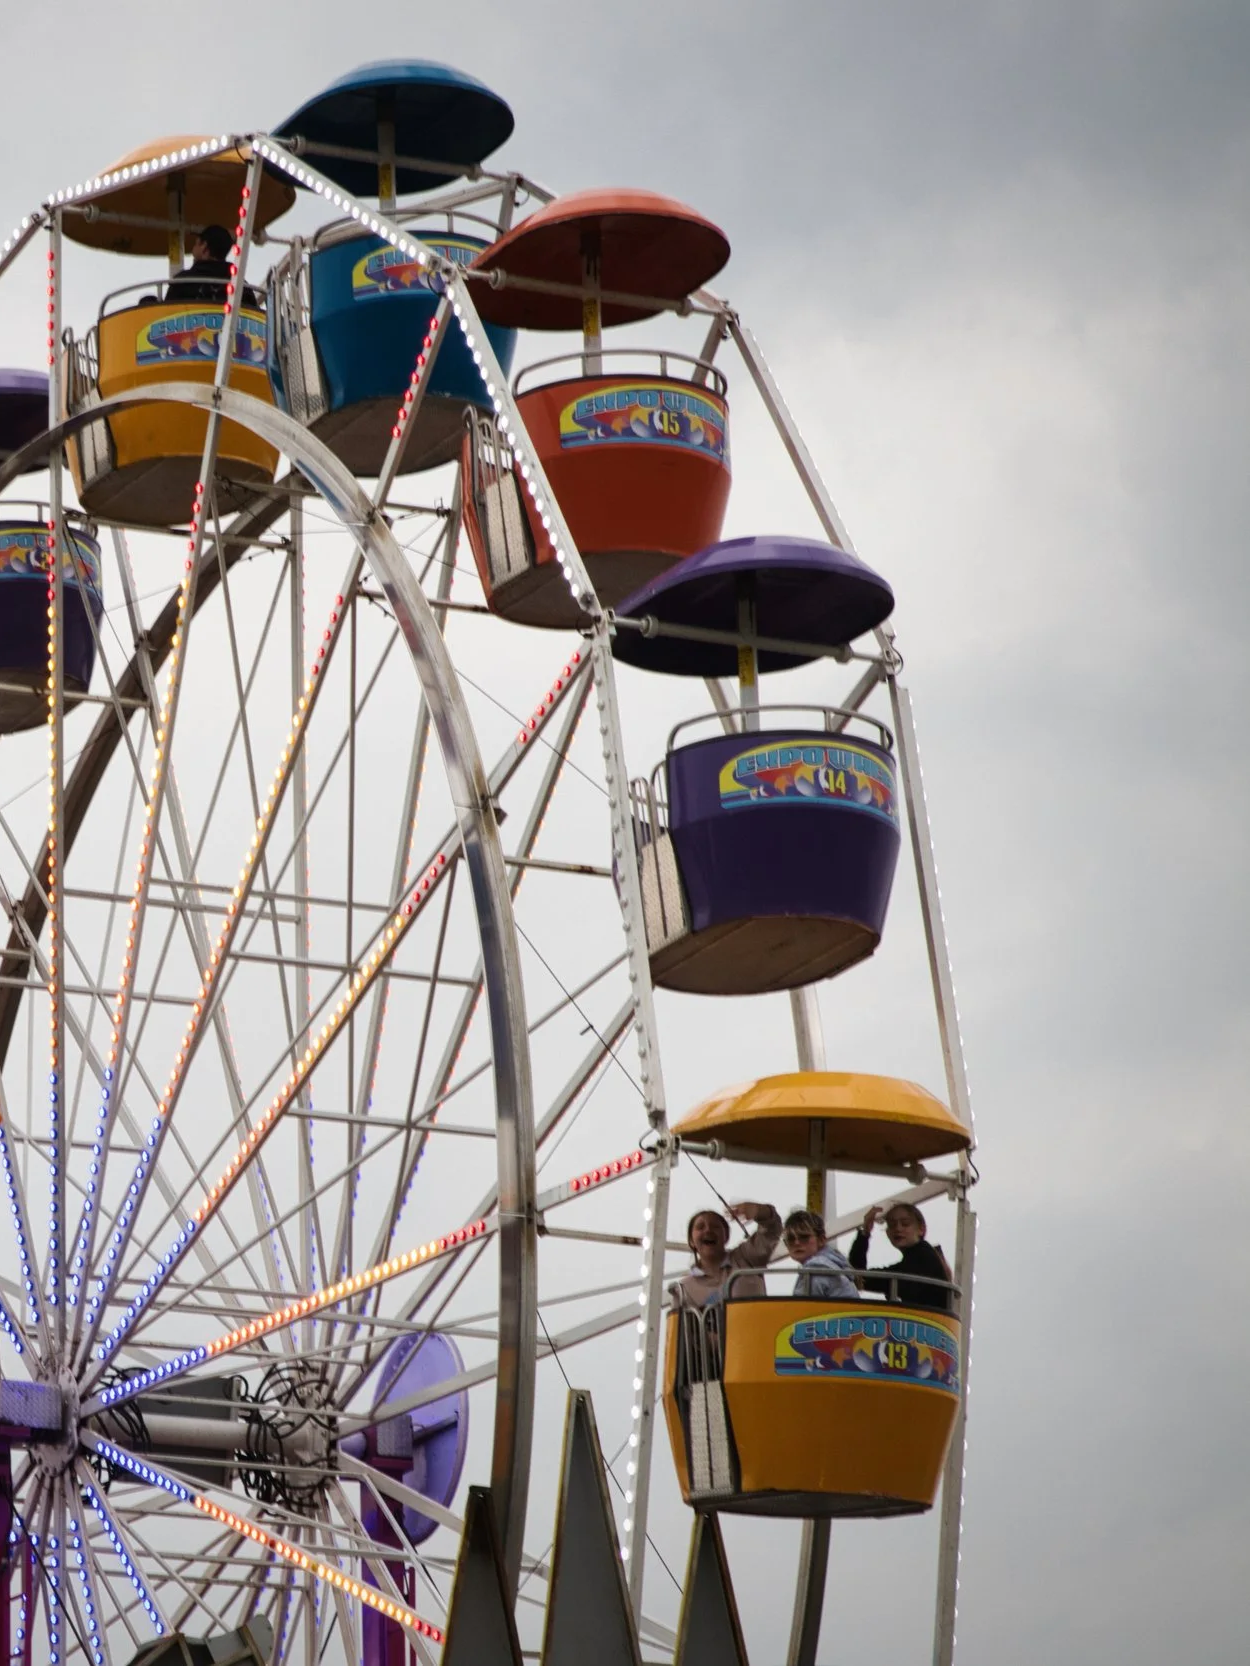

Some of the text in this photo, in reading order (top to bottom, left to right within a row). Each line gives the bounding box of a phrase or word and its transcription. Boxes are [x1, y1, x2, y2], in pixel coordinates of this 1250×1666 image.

[576, 389, 660, 420] EXPO
[662, 410, 680, 435] 15
[736, 747, 825, 778] EXPO
[827, 768, 846, 795] 14
[793, 1317, 958, 1360] EXPO WHEE
[888, 1342, 908, 1370] 13
